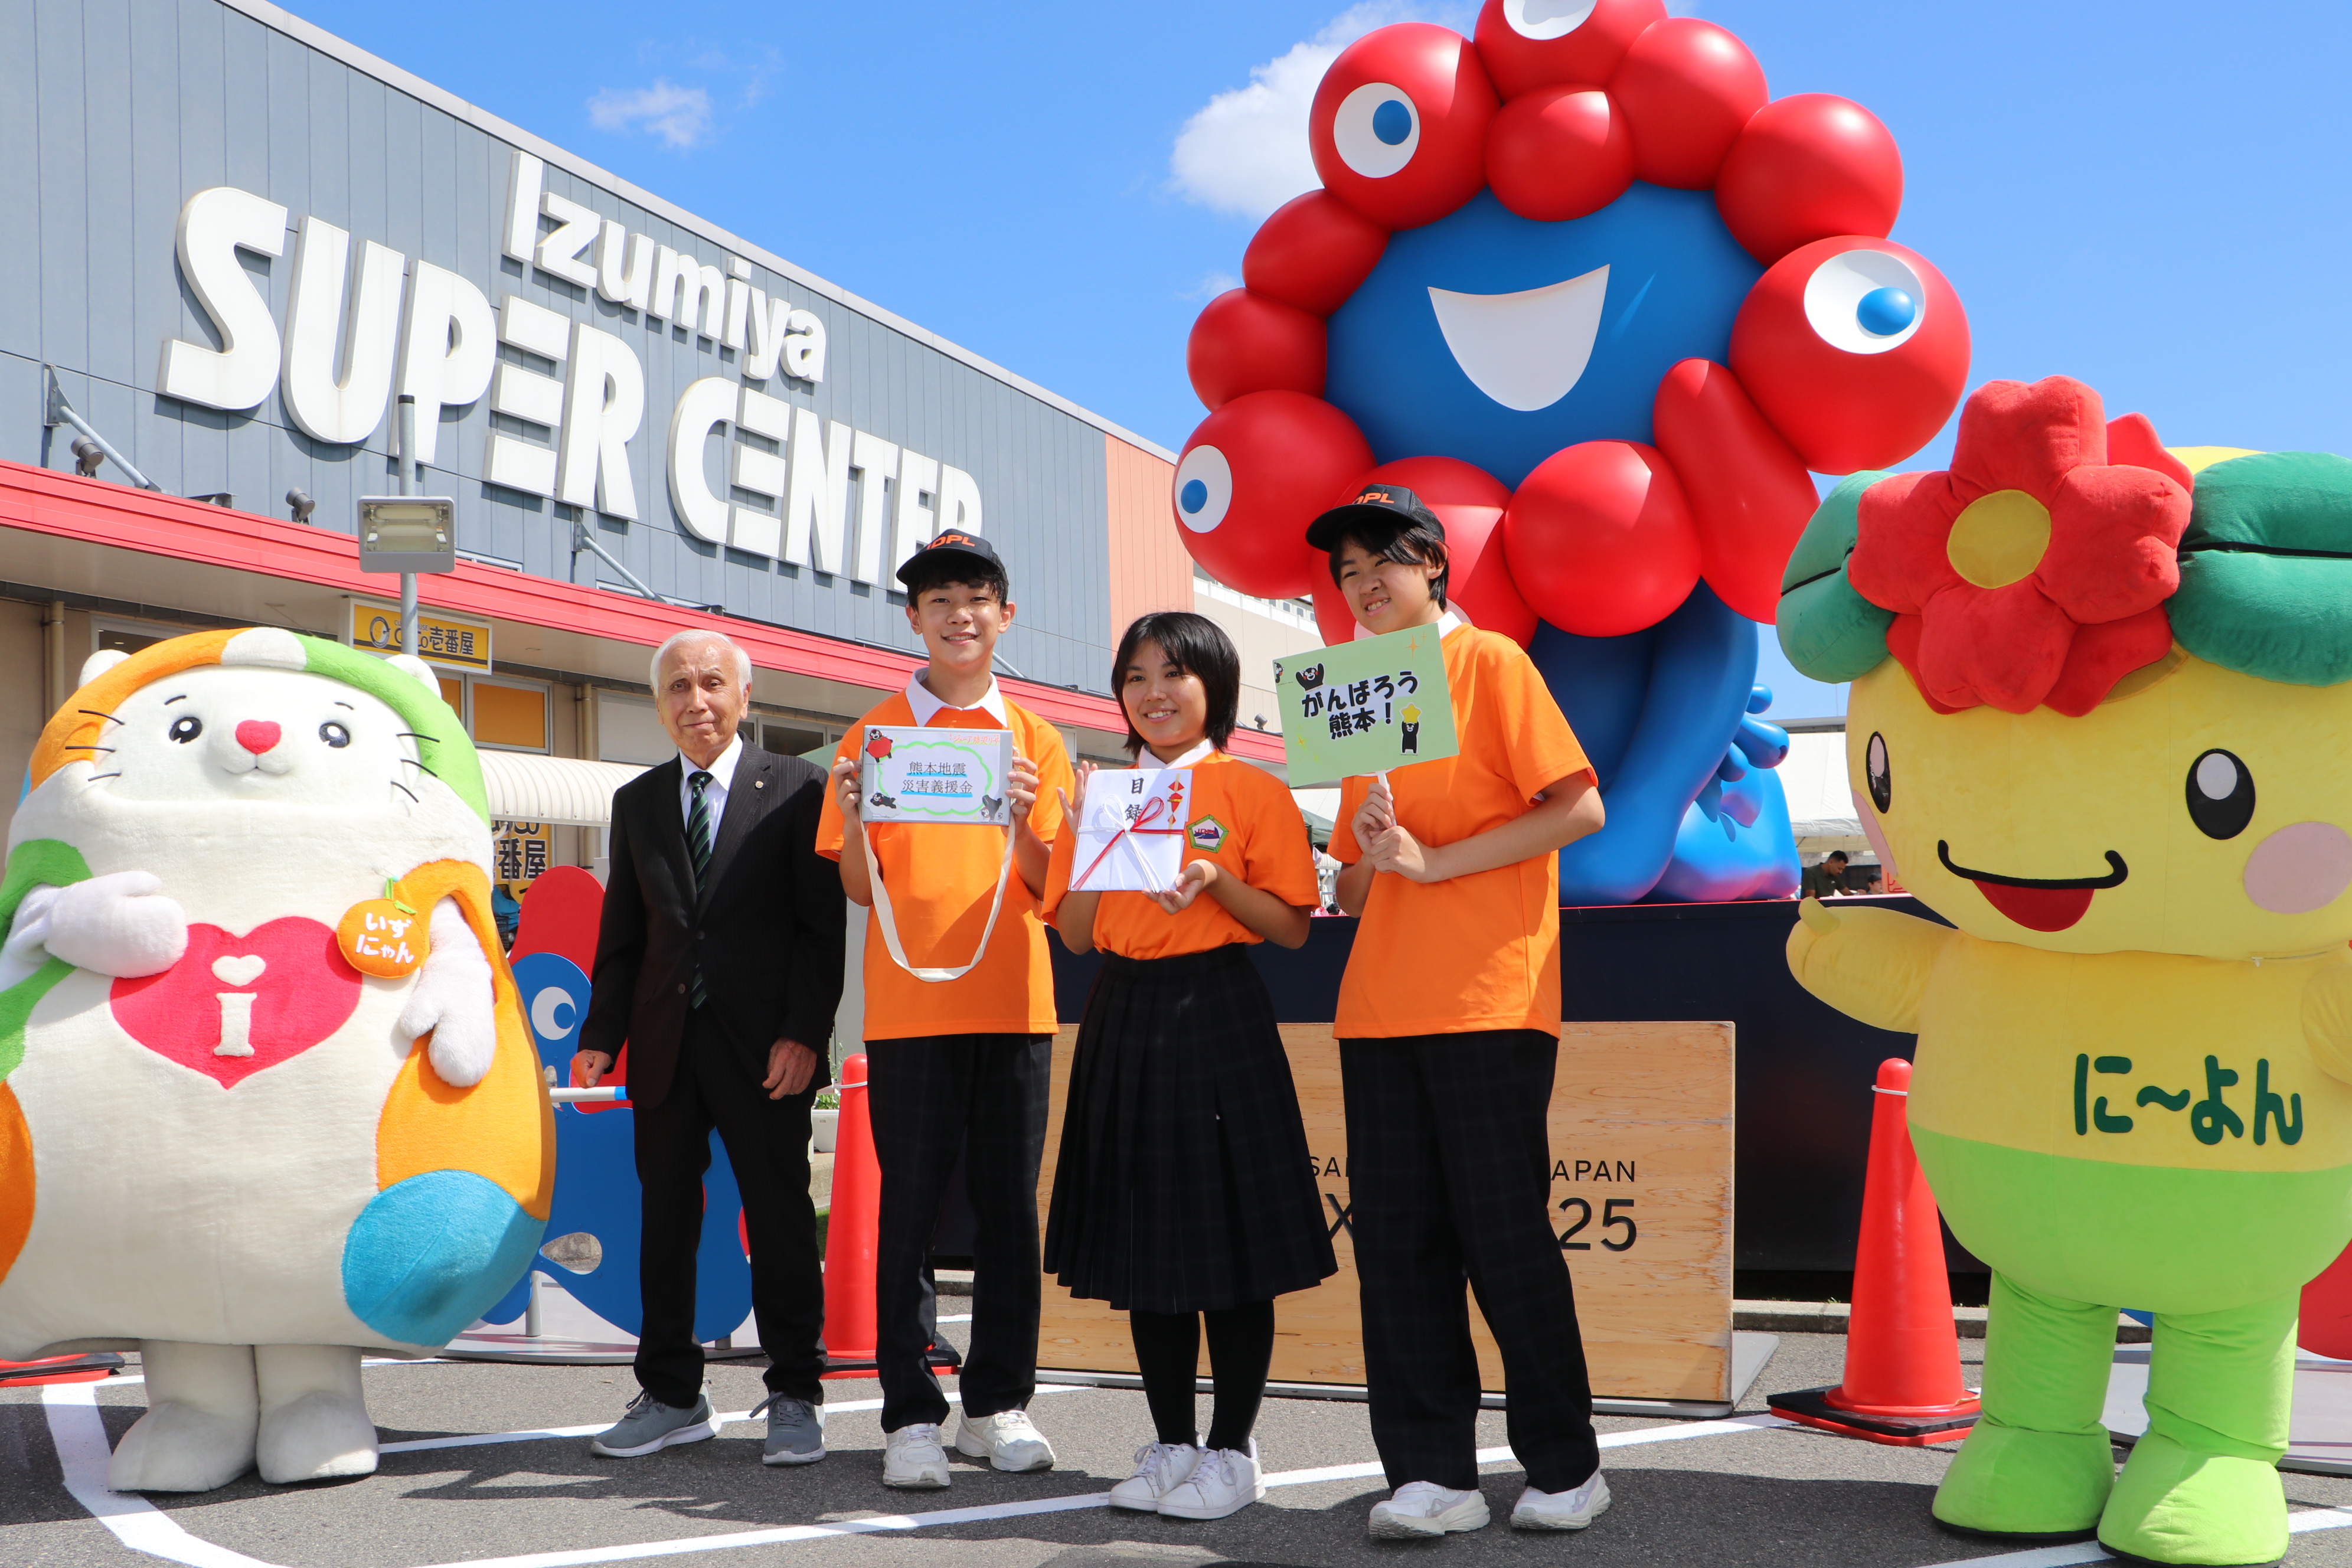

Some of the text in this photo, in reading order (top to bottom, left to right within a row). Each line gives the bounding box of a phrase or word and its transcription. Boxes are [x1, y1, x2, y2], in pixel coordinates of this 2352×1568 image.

[502, 151, 827, 383] Izumiya
[158, 187, 645, 520] SUPER
[1302, 671, 1418, 718] がんばろう
[901, 779, 974, 794] 災害義援金
[909, 762, 967, 776] 熊本地震
[1125, 777, 1144, 821] 目録
[494, 838, 546, 880] 番屋
[365, 912, 412, 939] いず
[355, 933, 414, 964] にゃん
[1551, 1160, 1635, 1182] APAN
[1559, 1197, 1637, 1252] 25
